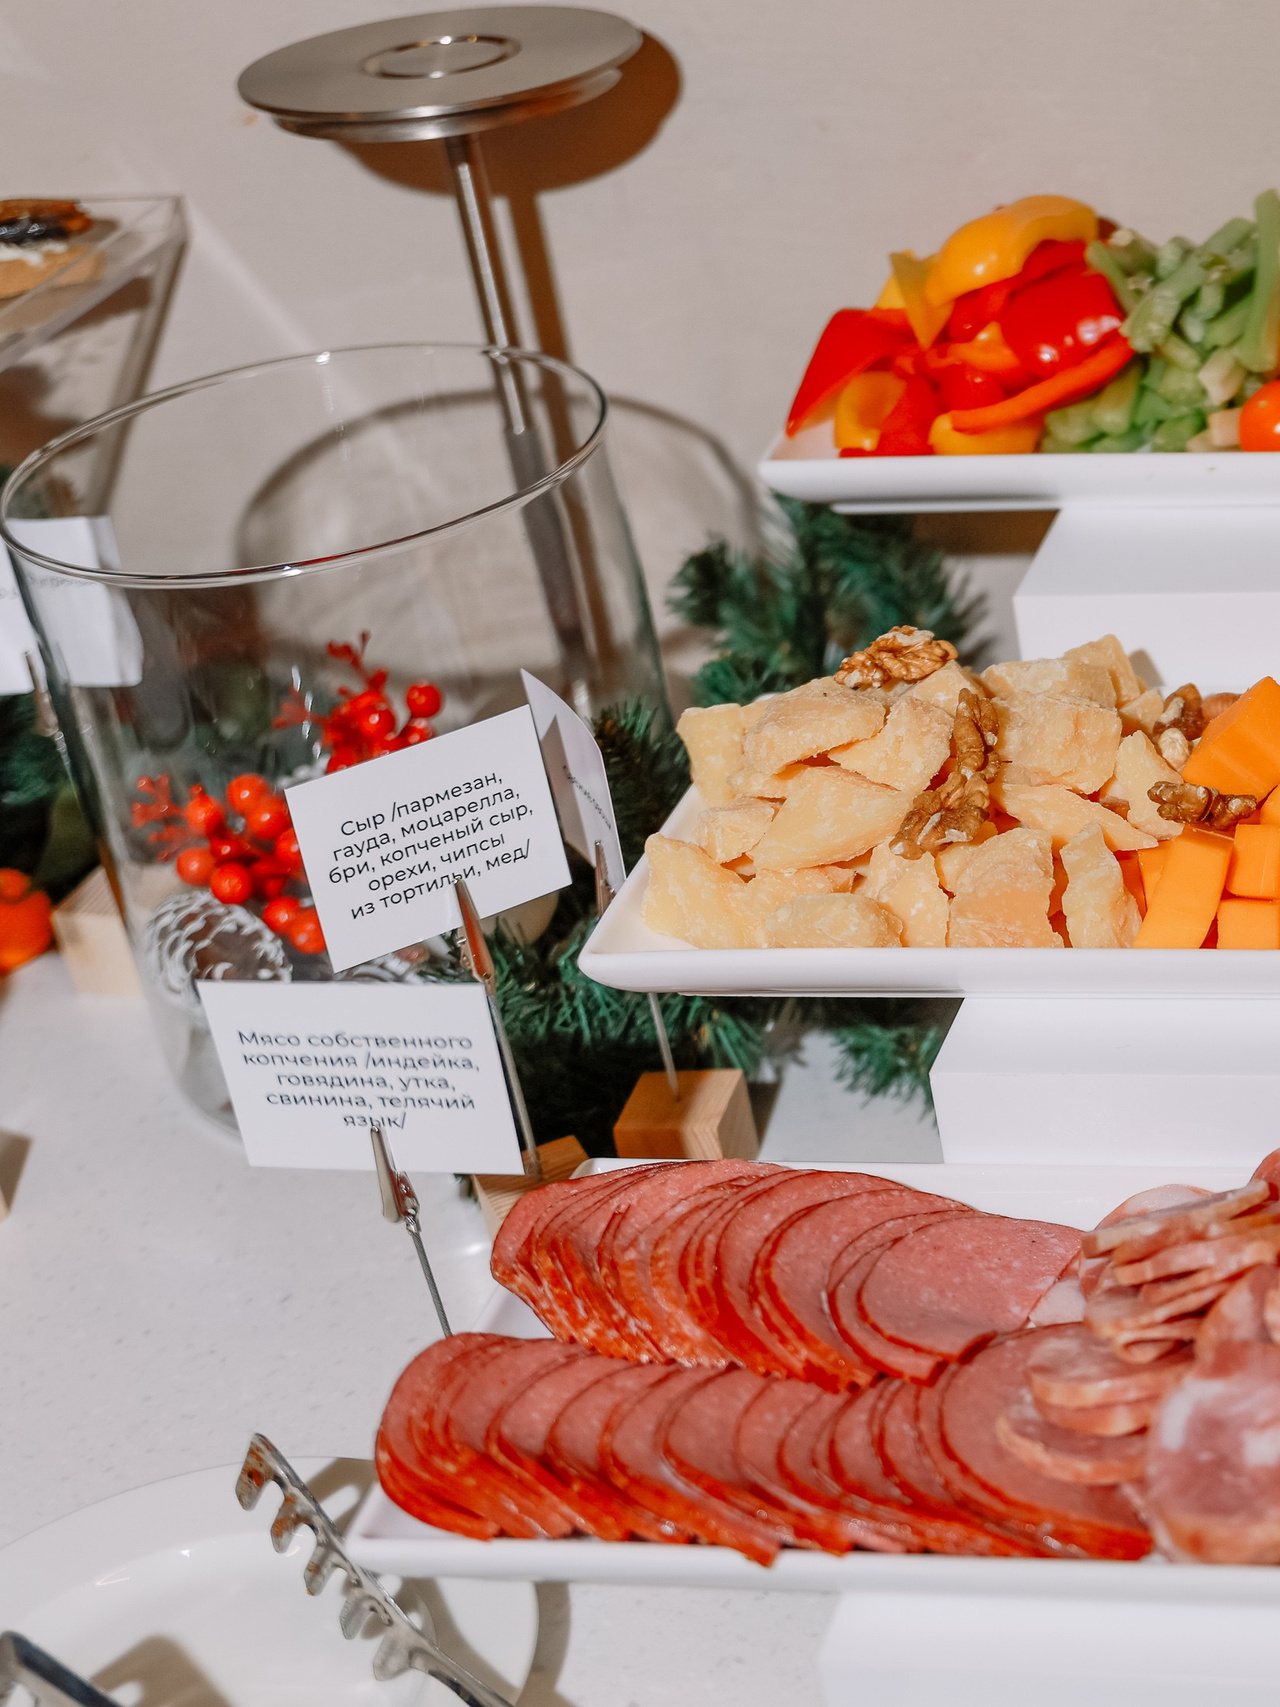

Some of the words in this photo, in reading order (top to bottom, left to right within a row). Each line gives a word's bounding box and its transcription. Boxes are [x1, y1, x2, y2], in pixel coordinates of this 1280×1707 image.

[333, 831, 397, 862] гауда,
[400, 788, 521, 838] моцарелла,
[340, 813, 385, 837] Сыр
[391, 772, 504, 822] /пармезан,
[328, 857, 376, 884] бри,
[380, 819, 484, 867] копченый
[489, 803, 534, 828] сыр,
[368, 860, 438, 892] орехи,
[440, 834, 507, 864] чипсы
[351, 902, 376, 920] из
[486, 838, 532, 871] мед/
[238, 1030, 300, 1048] Мясо
[308, 1031, 474, 1050] собственного
[243, 1053, 358, 1067] копчения
[365, 1051, 480, 1071] /индейка,
[266, 1093, 373, 1108] свинина,
[378, 1094, 475, 1110] телячий
[276, 1074, 394, 1090] говядина,
[398, 1076, 456, 1091] утка,
